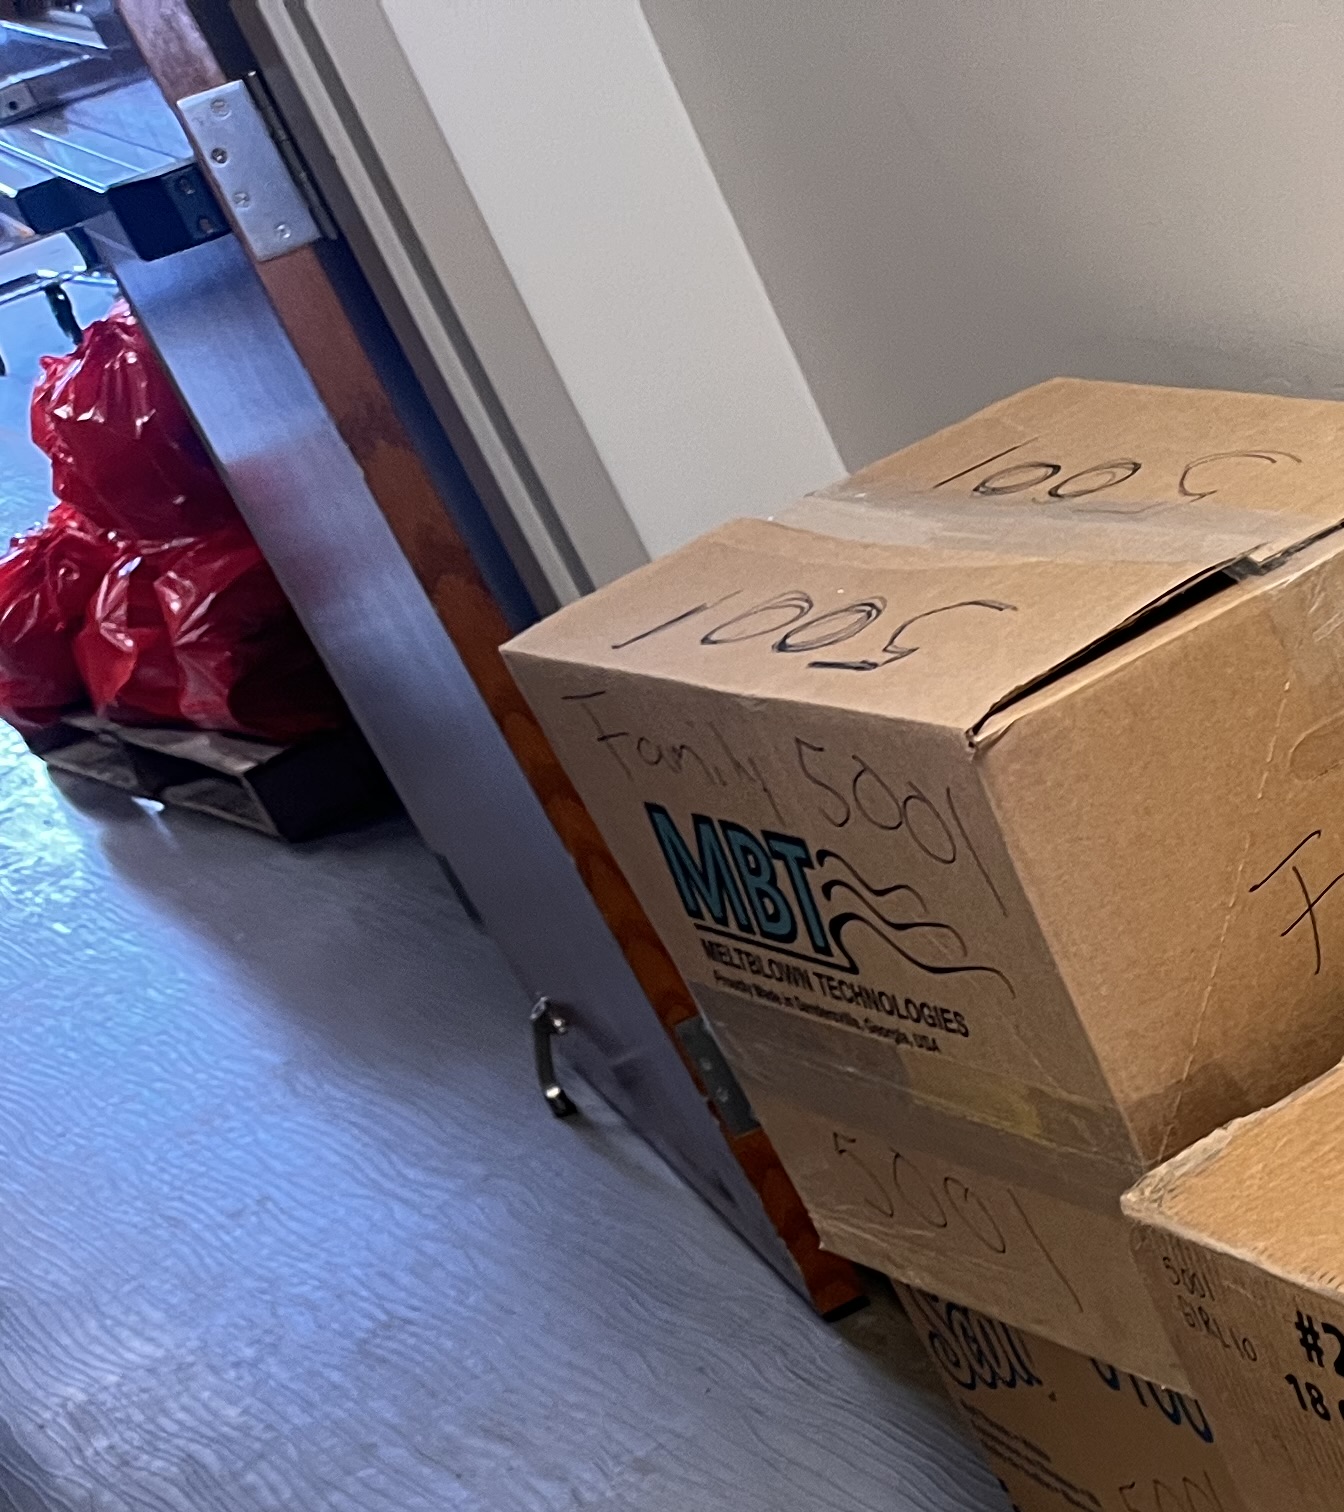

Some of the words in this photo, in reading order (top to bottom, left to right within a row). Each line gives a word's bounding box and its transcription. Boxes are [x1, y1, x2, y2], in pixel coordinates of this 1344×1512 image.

[643, 801, 833, 957] MBT
[701, 938, 814, 993] MELTBLOWN
[812, 970, 970, 1038] TECHNOLOGIES
[1284, 1373, 1332, 1423] 18
